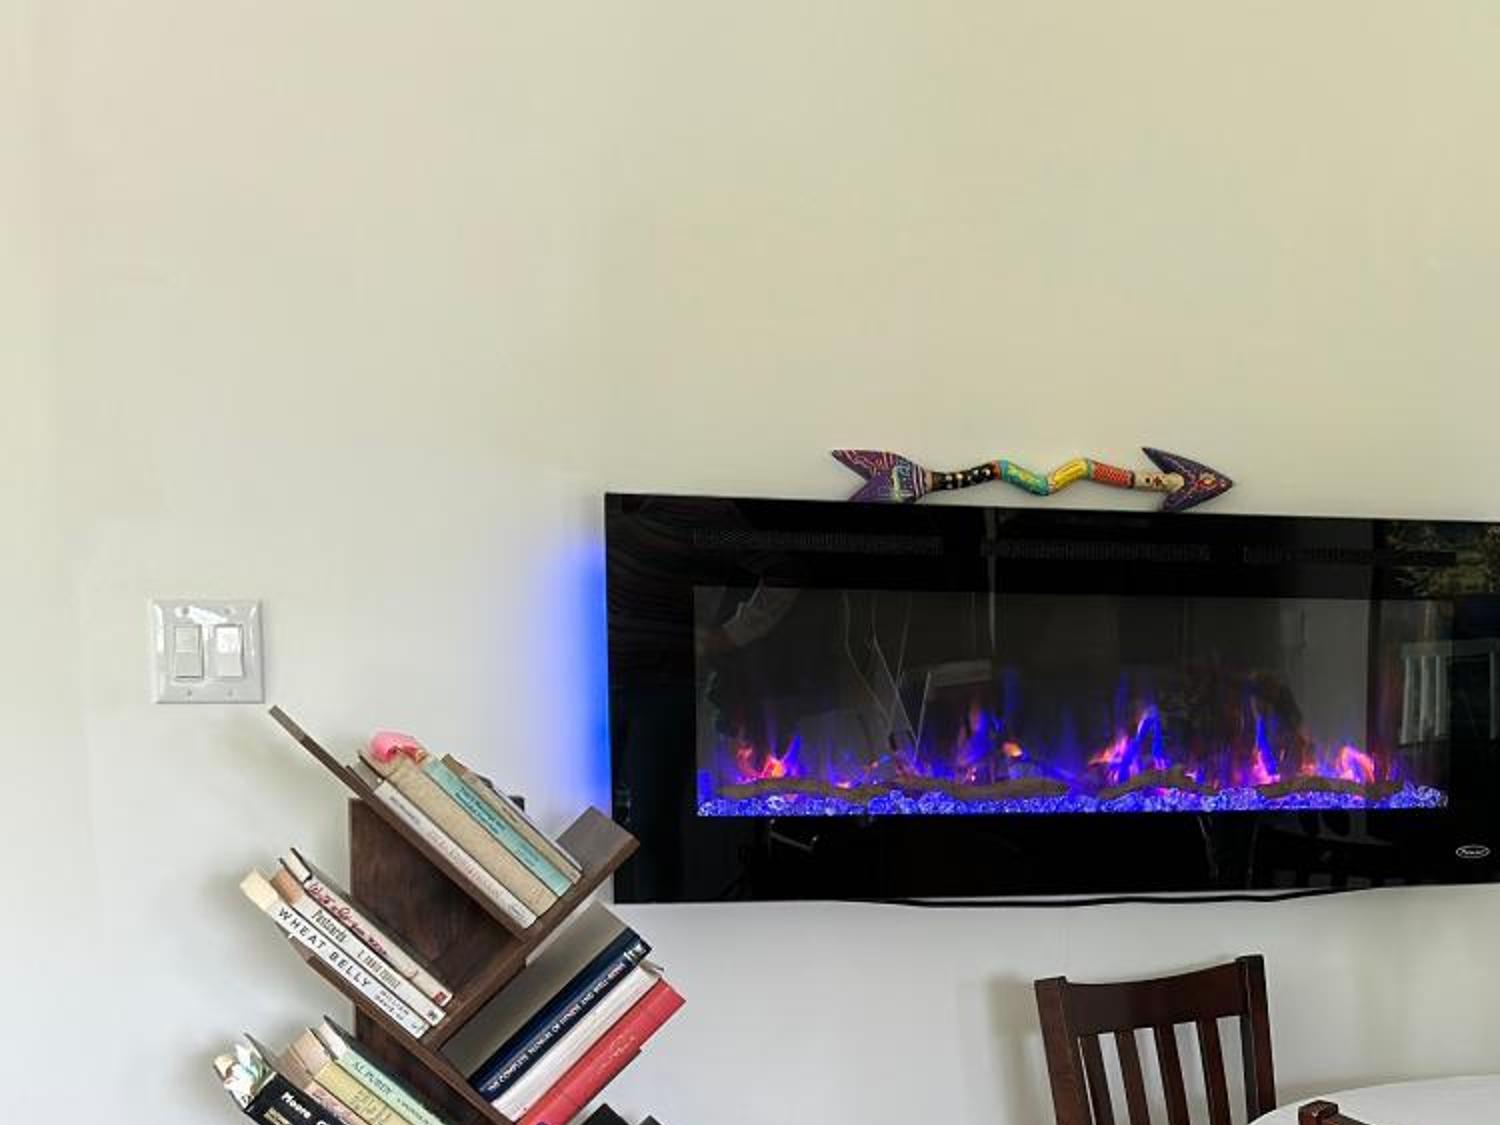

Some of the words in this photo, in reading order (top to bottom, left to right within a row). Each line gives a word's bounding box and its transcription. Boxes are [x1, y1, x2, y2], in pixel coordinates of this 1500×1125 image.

[278, 906, 327, 949] WHEAT
[329, 950, 371, 987] BELLY
[281, 1091, 312, 1119] Moore
